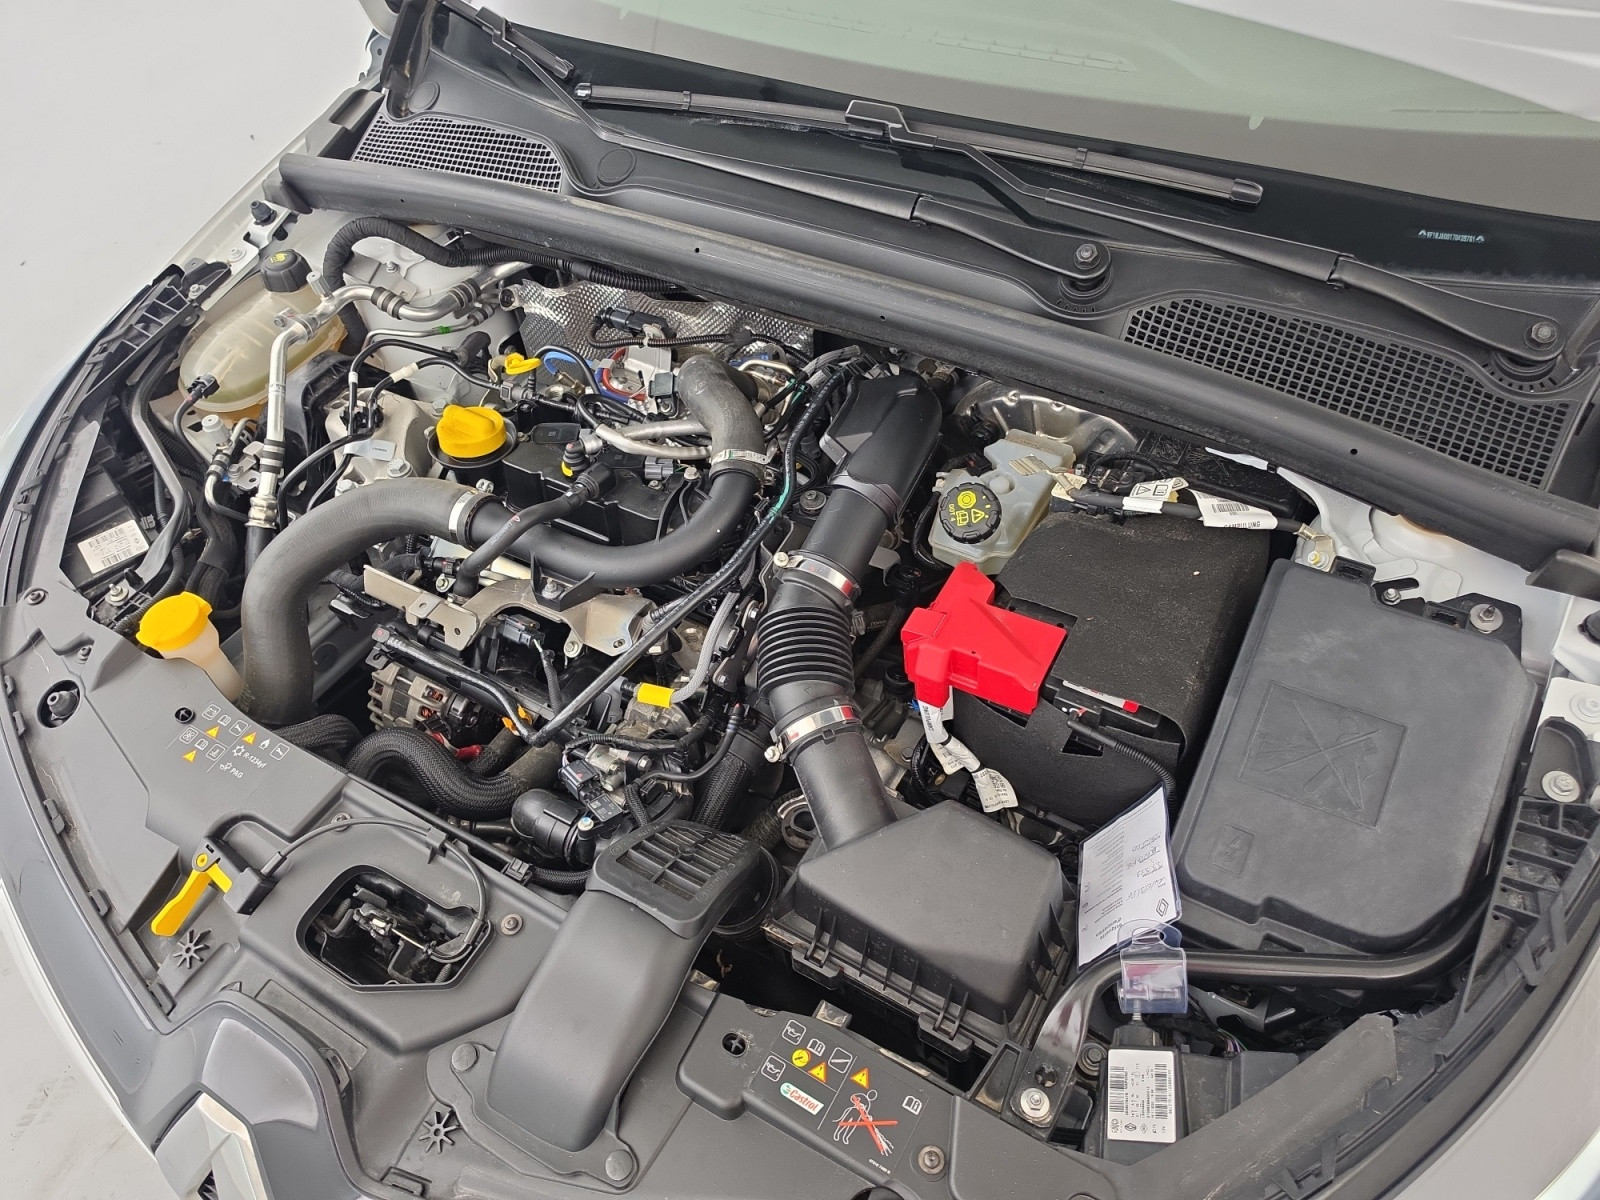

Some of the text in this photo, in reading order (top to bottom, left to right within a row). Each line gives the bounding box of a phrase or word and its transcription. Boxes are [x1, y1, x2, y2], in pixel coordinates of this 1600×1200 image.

[948, 503, 956, 516] DOT
[242, 752, 268, 768] R-1234yf
[230, 767, 244, 779] PAG
[789, 1089, 820, 1112] Castrol
